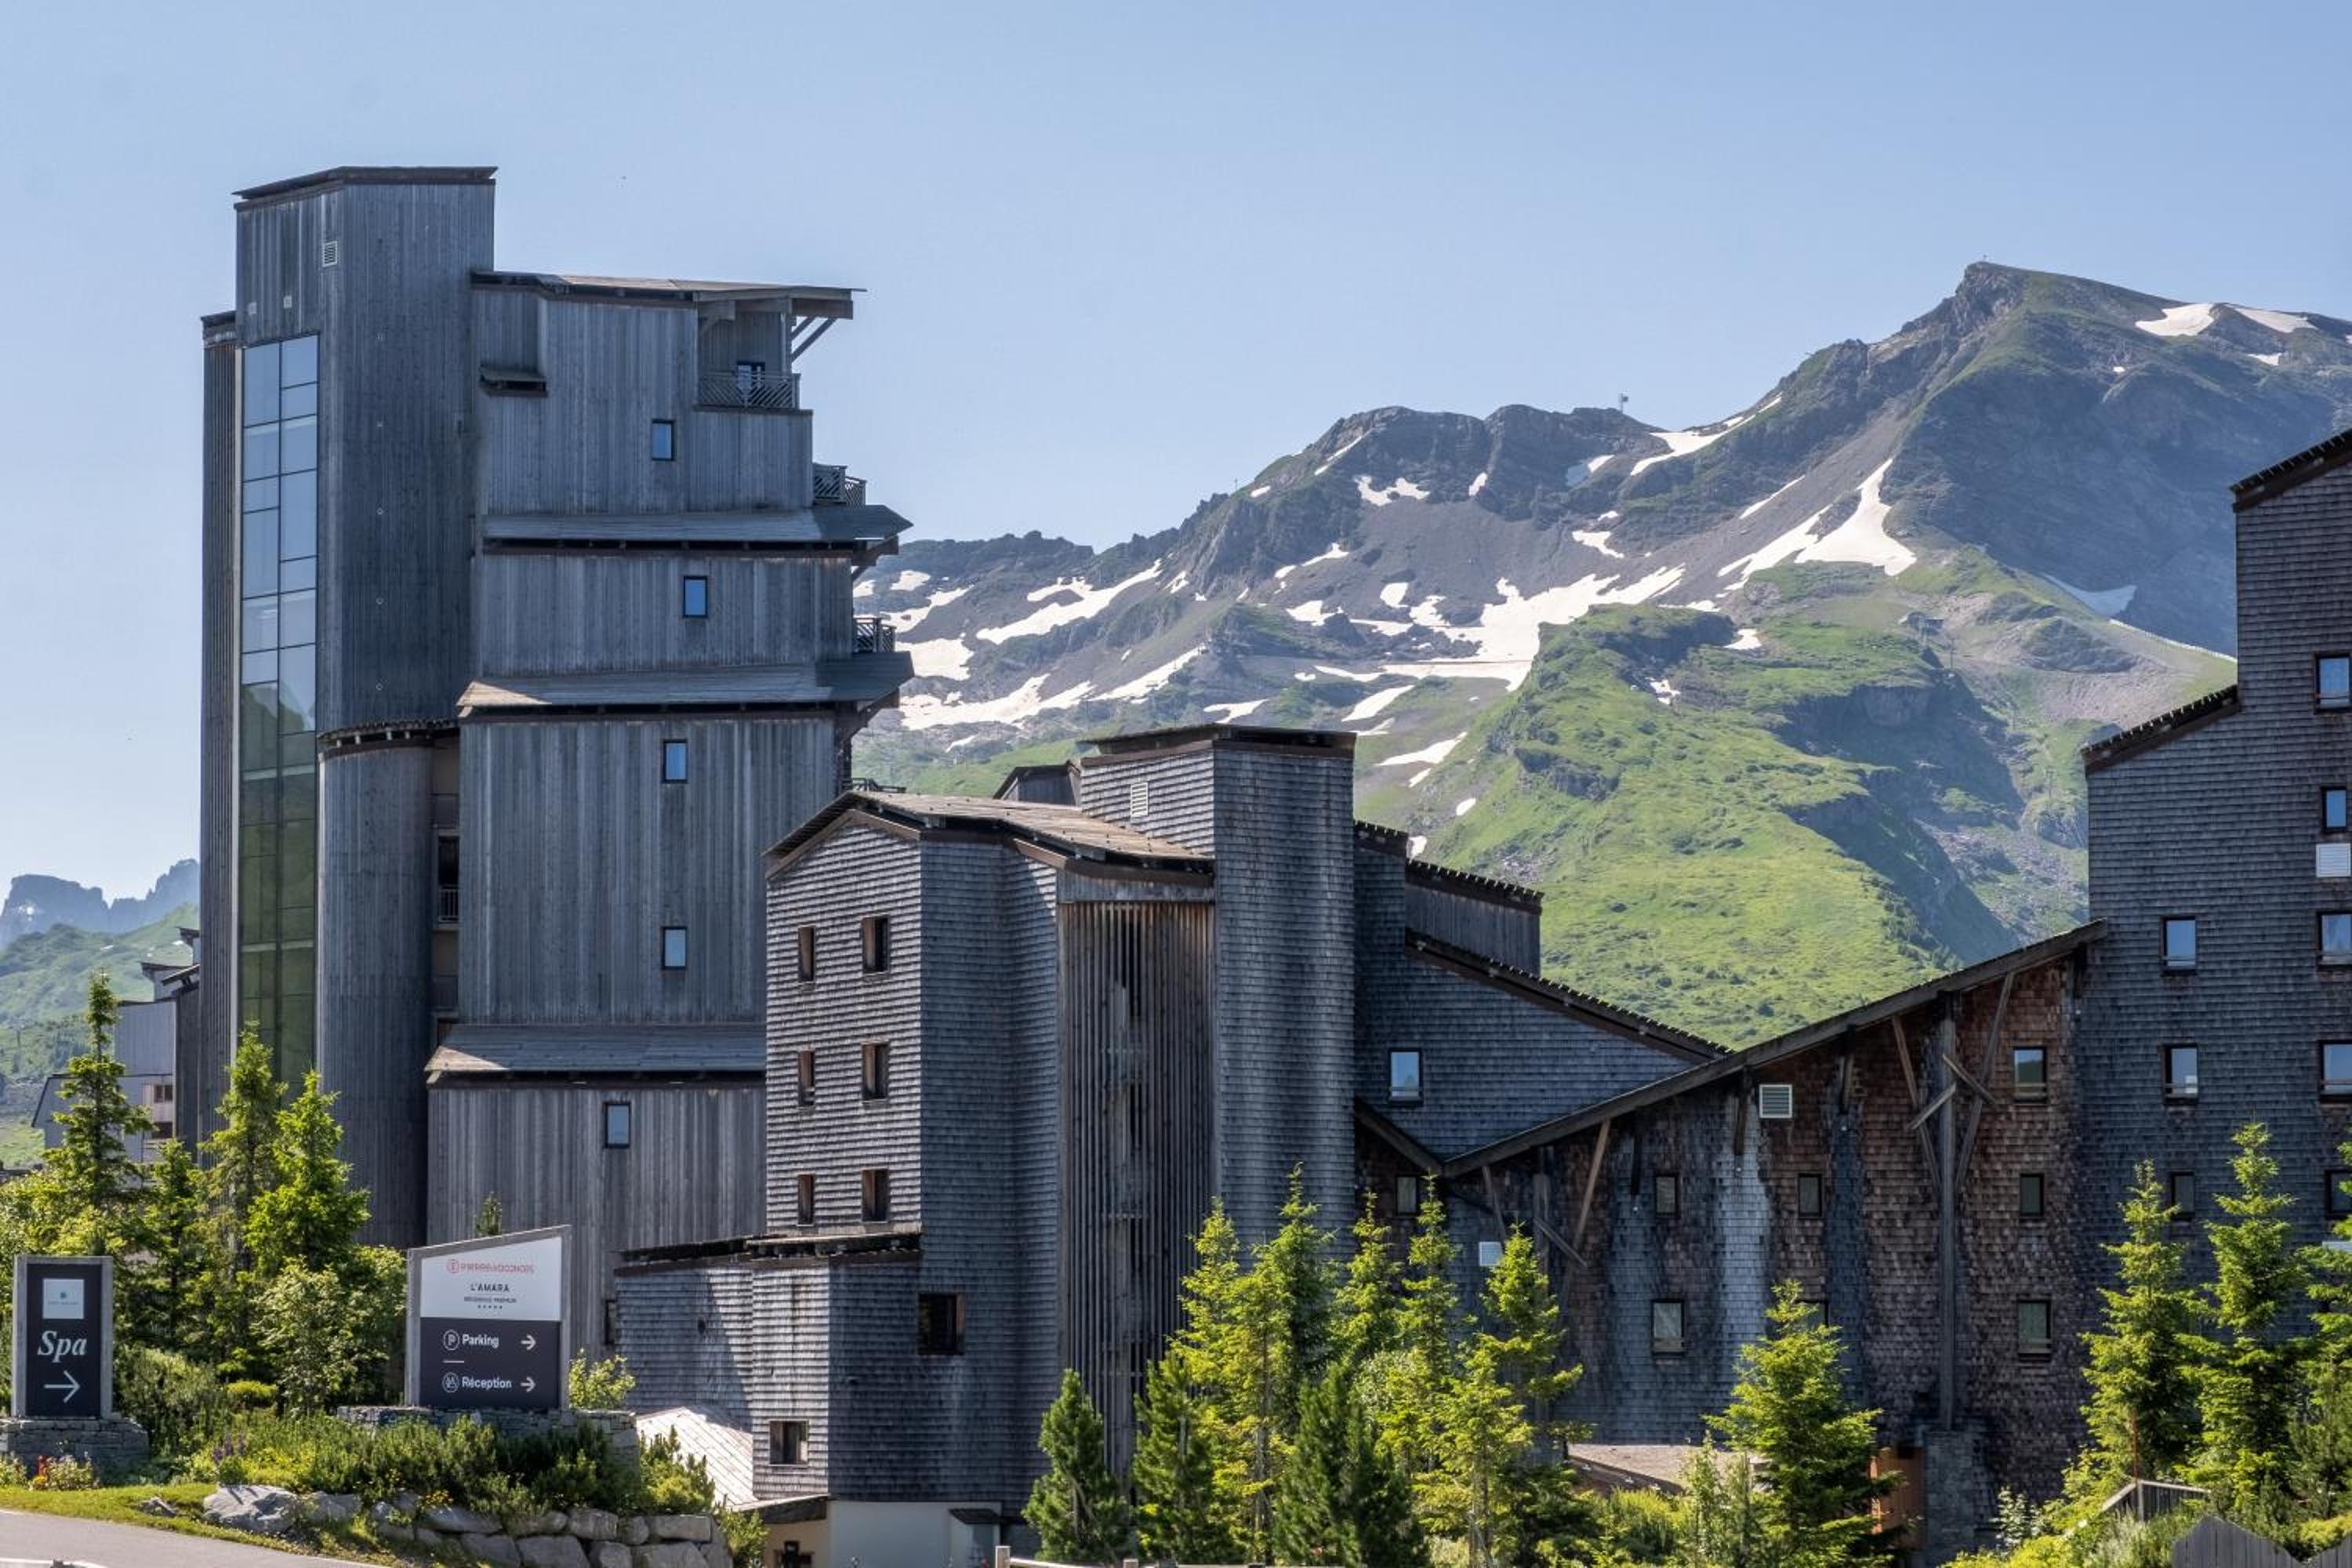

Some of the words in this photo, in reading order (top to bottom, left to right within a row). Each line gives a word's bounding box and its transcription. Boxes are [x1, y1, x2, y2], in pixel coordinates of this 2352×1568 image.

[470, 1283, 510, 1292] L'AMARA
[37, 1330, 87, 1363] Spa
[462, 1334, 499, 1348] Parking
[462, 1376, 512, 1391] Réception
